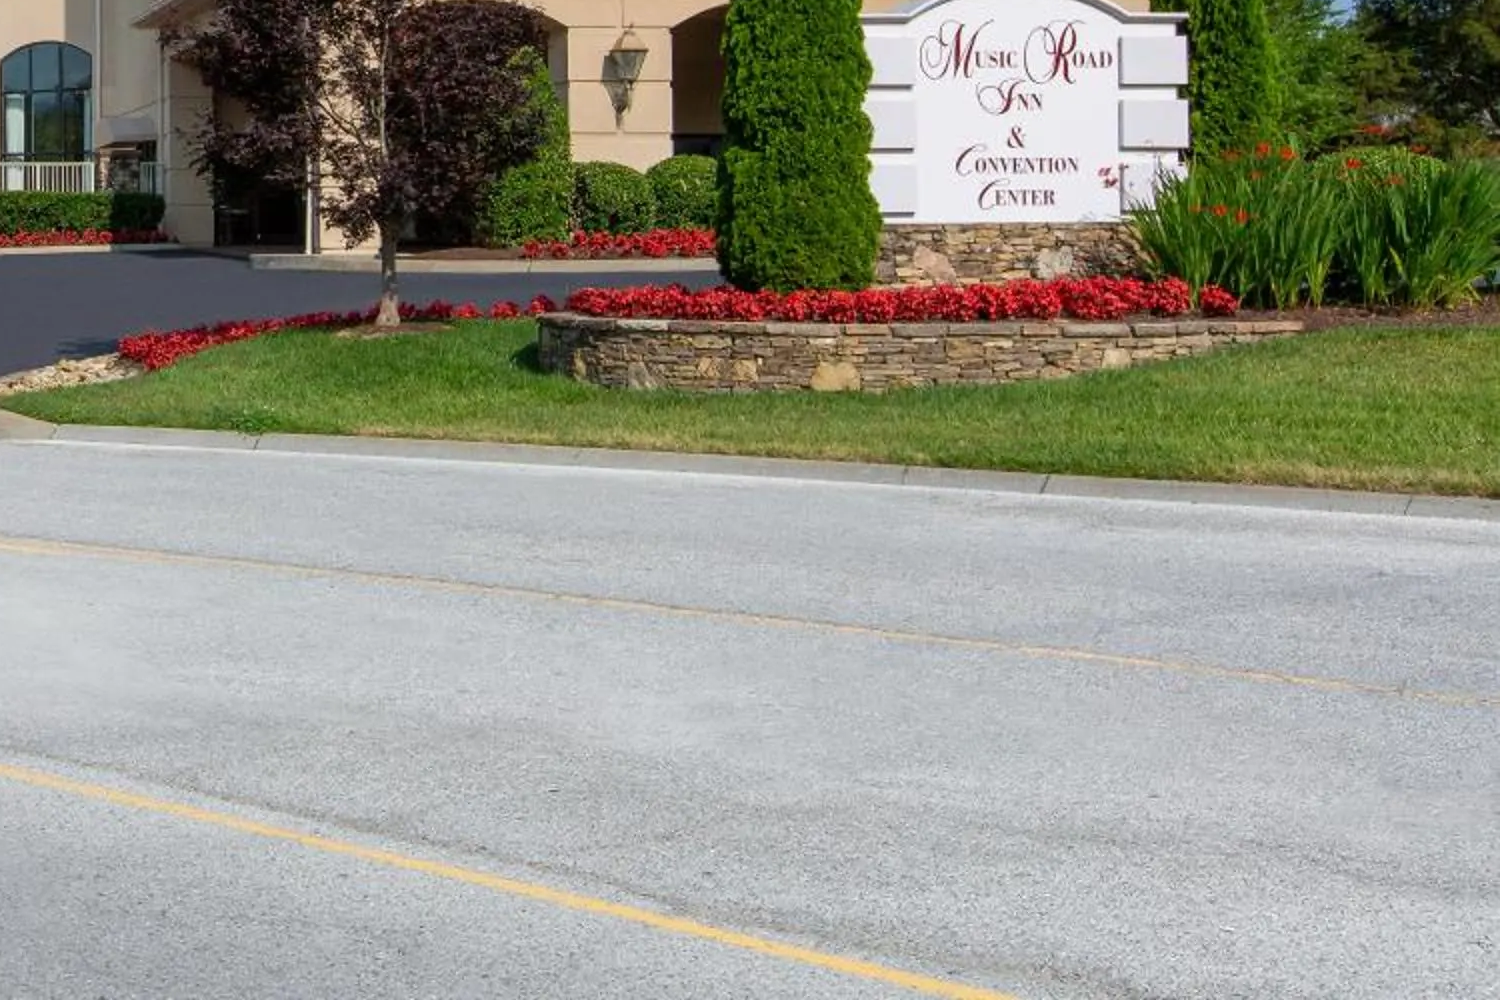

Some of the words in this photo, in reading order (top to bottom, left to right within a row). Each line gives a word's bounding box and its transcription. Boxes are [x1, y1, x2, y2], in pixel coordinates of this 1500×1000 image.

[1007, 126, 1026, 148] &
[955, 145, 1079, 177] CONVENTION
[978, 180, 1055, 211] CENTER
